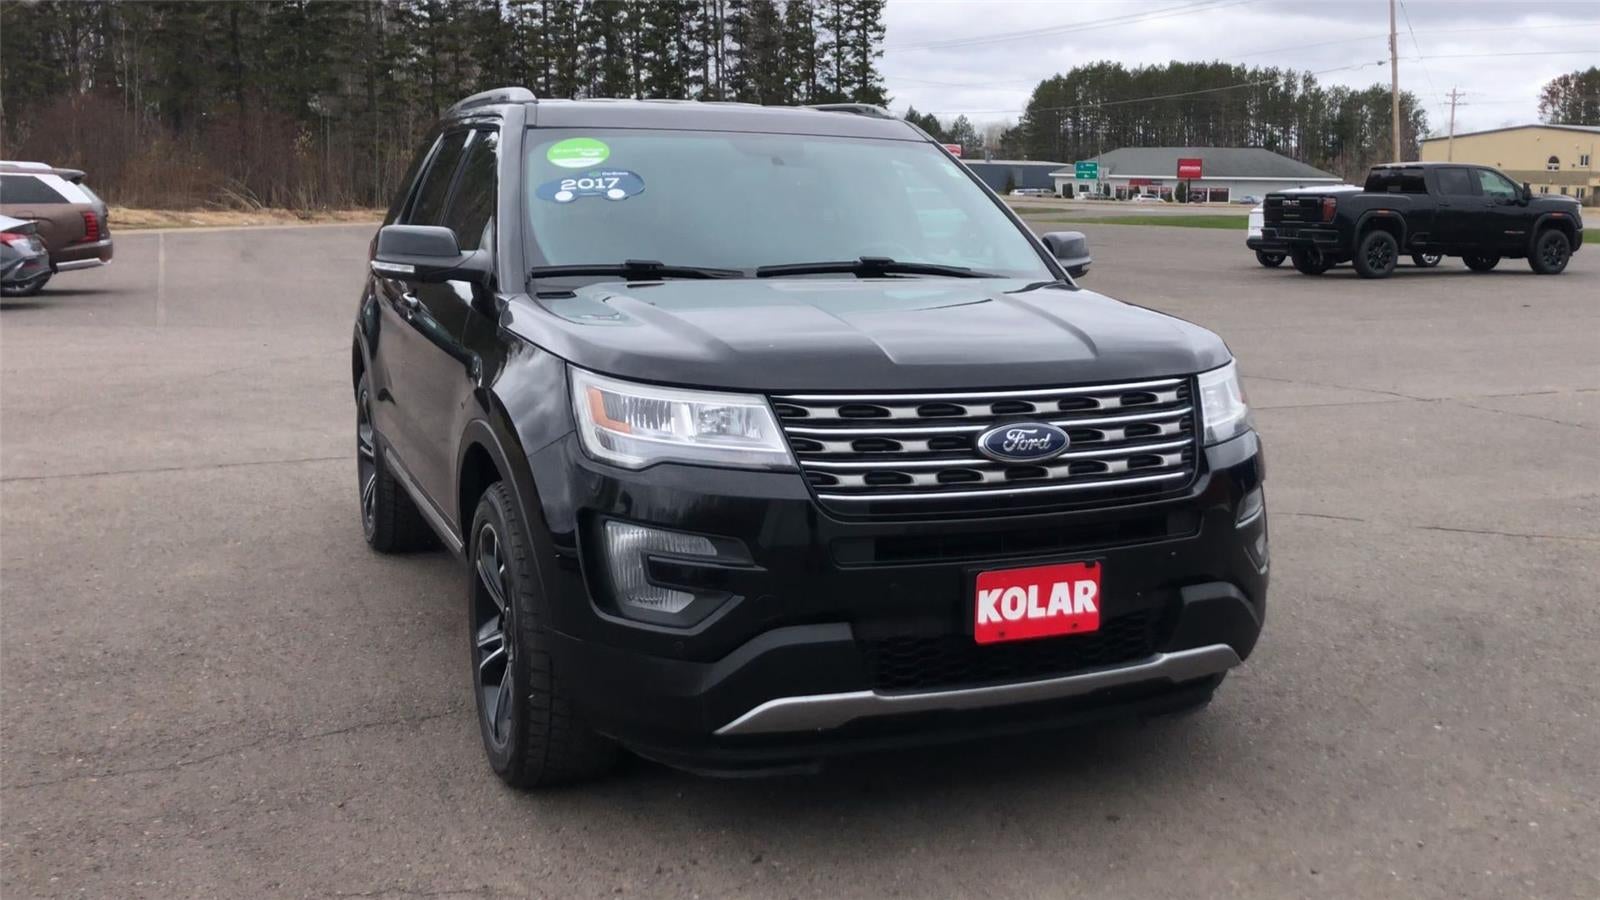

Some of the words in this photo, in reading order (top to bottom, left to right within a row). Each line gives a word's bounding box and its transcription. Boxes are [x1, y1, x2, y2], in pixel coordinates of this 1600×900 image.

[561, 177, 620, 191] 2017
[1003, 428, 1052, 452] Ford
[977, 579, 1098, 625] KOLAR
